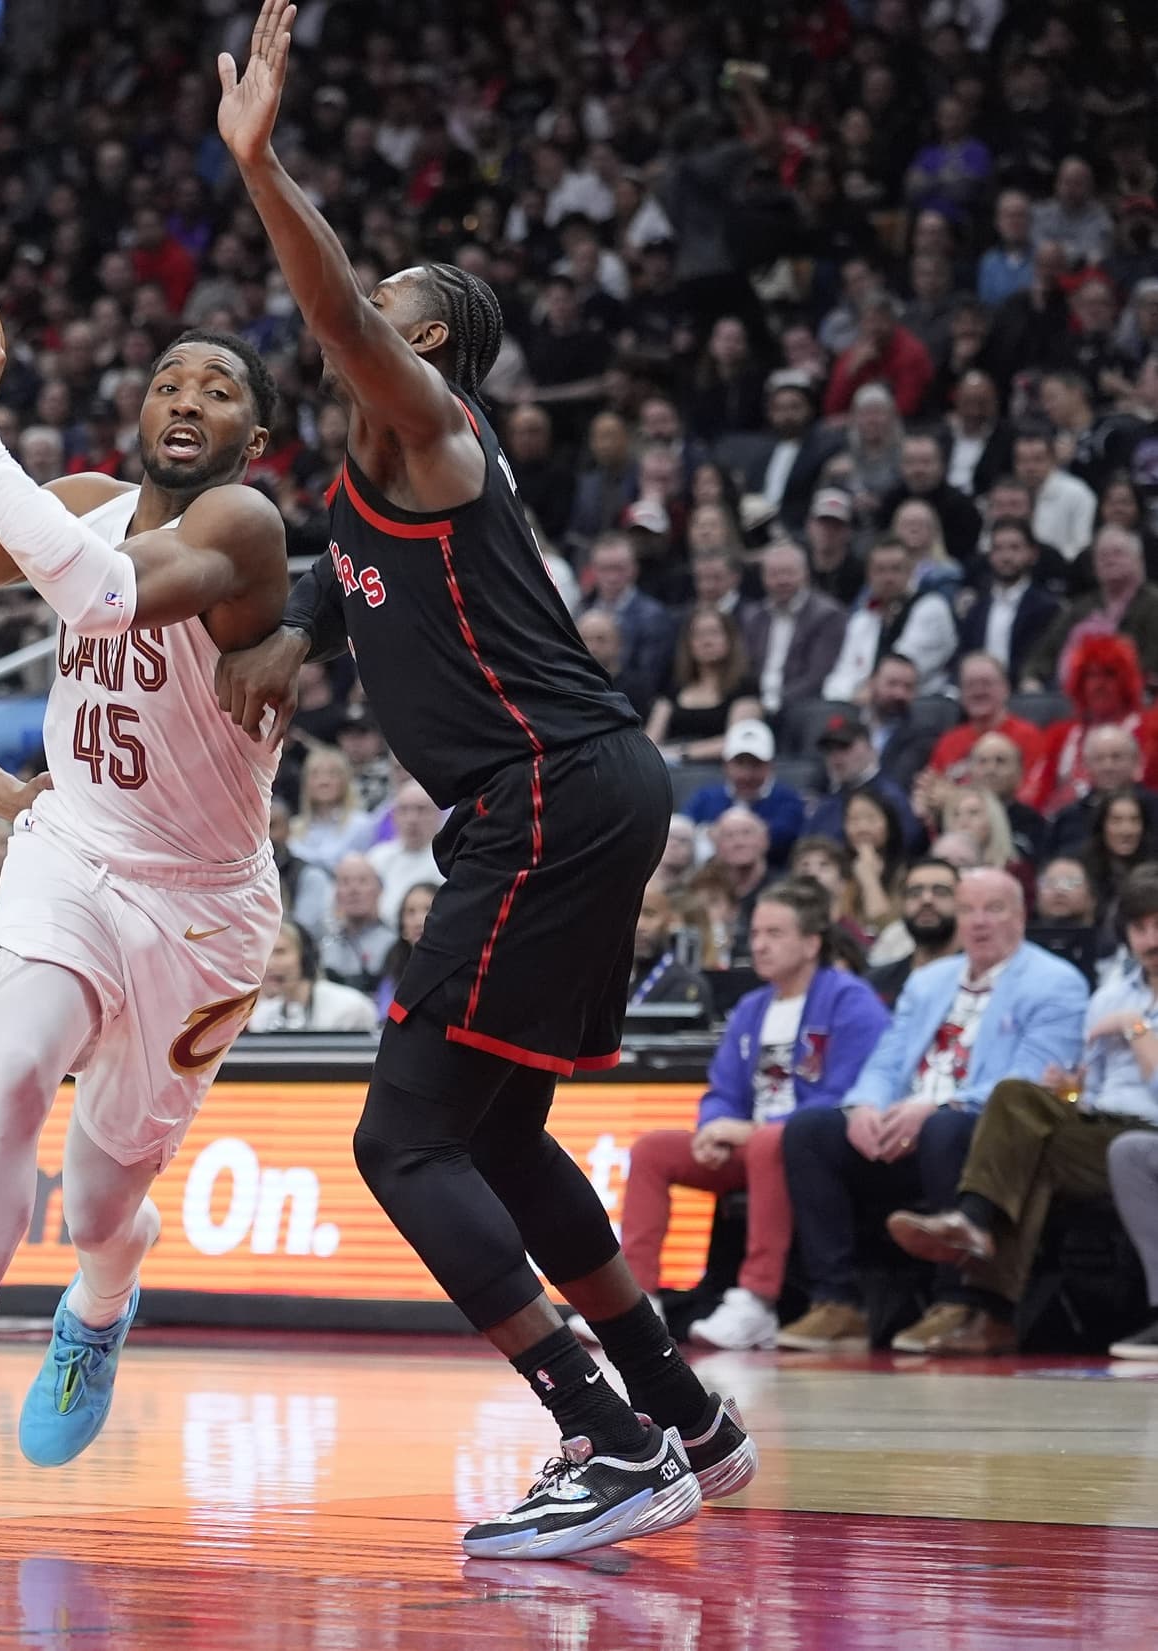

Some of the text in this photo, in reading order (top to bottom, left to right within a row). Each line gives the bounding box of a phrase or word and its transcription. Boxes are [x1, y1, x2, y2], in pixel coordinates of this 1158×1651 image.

[58, 619, 168, 692] CAVS
[73, 698, 148, 791] 45
[181, 1137, 340, 1257] On.
